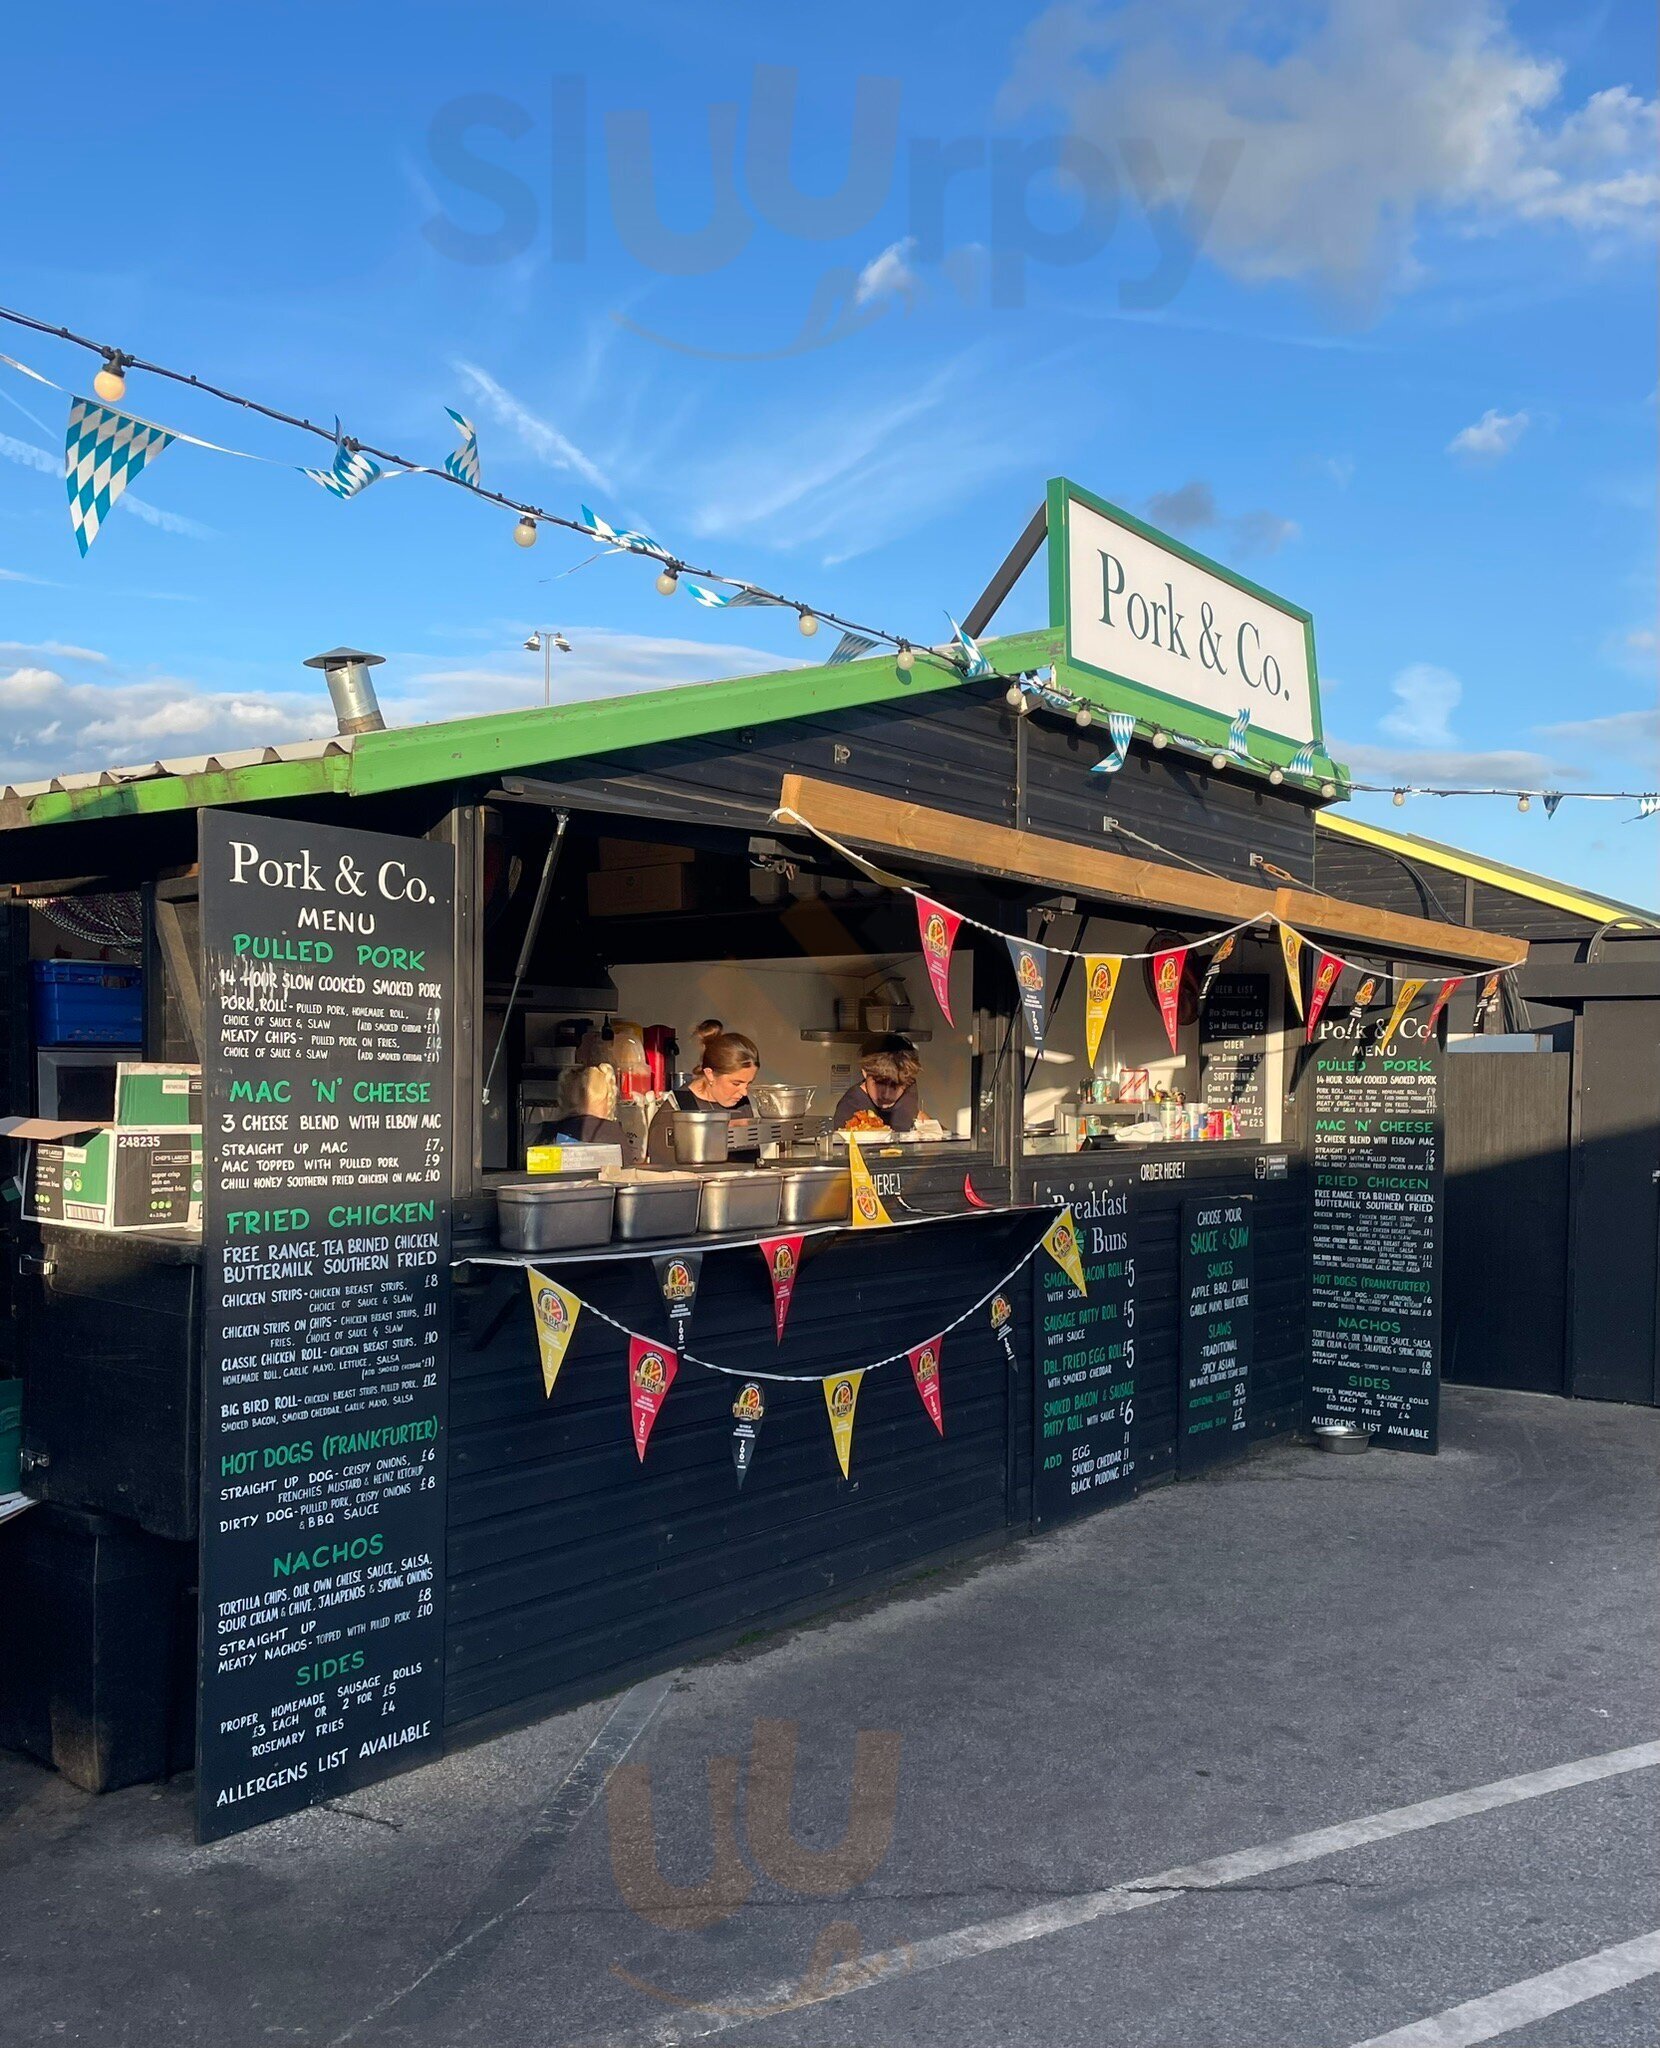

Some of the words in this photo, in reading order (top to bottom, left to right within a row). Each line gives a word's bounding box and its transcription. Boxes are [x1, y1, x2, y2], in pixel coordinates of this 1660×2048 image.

[1097, 549, 1190, 660] Pork
[1200, 601, 1227, 675] &
[1237, 622, 1289, 702] Co.
[229, 842, 326, 891] Pork
[335, 855, 367, 896] &
[378, 861, 435, 904] Co.
[298, 907, 376, 934] MENU
[232, 934, 334, 964] PULLED
[357, 945, 426, 971] PORK
[219, 968, 236, 986] 14
[240, 970, 278, 989] HOUR
[282, 972, 314, 991] SLOW
[318, 975, 365, 994] COOKED
[372, 979, 414, 996] SMOKED
[418, 983, 442, 999] PORK
[1318, 1020, 1368, 1040] Pok
[1352, 1045, 1397, 1056] MENU
[1317, 1060, 1366, 1072] PULLED
[1383, 1060, 1432, 1072] PORK
[1345, 1076, 1363, 1084] SLOW
[1364, 1076, 1387, 1084] COOKED
[1418, 1076, 1437, 1085] PORK
[230, 1080, 292, 1104] MAC
[353, 1082, 431, 1104] CHEESE
[221, 1114, 236, 1132] 3
[242, 1115, 289, 1132] CHEESE
[300, 1115, 339, 1130] BLEND
[349, 1115, 380, 1130] WITH
[386, 1114, 417, 1130] ELBOW
[421, 1114, 442, 1128] MAC
[1315, 1120, 1345, 1131] MAC
[1380, 1121, 1434, 1133] CHEESE
[119, 1136, 161, 1148] 248235
[222, 1143, 284, 1156] STRAIGHT
[293, 1143, 309, 1154] UP
[320, 1142, 348, 1154] MAC
[222, 1161, 249, 1173] MAC
[256, 1160, 295, 1171] TOPPED
[304, 1159, 331, 1170] WITH
[339, 1158, 372, 1168] PULLED
[378, 1157, 399, 1168] PORK
[425, 1154, 440, 1166] £9
[1141, 1163, 1164, 1181] ORDER
[1164, 1162, 1186, 1180] HERE!
[221, 1178, 250, 1189] CHILLI
[254, 1177, 282, 1189] HONEY
[287, 1176, 328, 1187] SOUTHERN
[332, 1176, 354, 1186] FRIED
[358, 1174, 388, 1184] CHICKEN
[393, 1173, 402, 1183] ON
[406, 1173, 422, 1182] MAC
[425, 1170, 441, 1182] £10
[1318, 1175, 1358, 1187] FRIED
[1367, 1177, 1429, 1190] CHICKEN
[227, 1208, 310, 1235] FRIED
[328, 1200, 435, 1228] CHICKEN
[1197, 1209, 1221, 1226] CHOOSE
[1225, 1207, 1242, 1222] YOUR
[223, 1245, 260, 1263] FREE
[322, 1240, 343, 1256] TEA
[347, 1236, 389, 1254] BRINED
[1092, 1226, 1128, 1254] Buns
[1190, 1230, 1218, 1255] SAUCE
[1229, 1226, 1249, 1250] SLAW
[223, 1261, 313, 1284] BUTTERMILK
[324, 1254, 389, 1275] SOUTHERN
[398, 1251, 437, 1268] FRIED
[1108, 1262, 1122, 1278] ROLL
[1124, 1258, 1135, 1288] £5
[1207, 1261, 1233, 1279] SAUCES
[670, 1286, 687, 1296] ABK
[1313, 1274, 1332, 1284] HOT
[1334, 1276, 1357, 1287] DOGS
[1044, 1311, 1076, 1332] SAUSAGE
[1080, 1307, 1100, 1324] PATTY
[1102, 1304, 1117, 1320] ROLL
[1124, 1299, 1134, 1328] £5
[1338, 1317, 1401, 1333] NACHOS
[1048, 1332, 1064, 1346] WITH
[1067, 1329, 1085, 1342] SAUCE
[1208, 1321, 1232, 1339] SLAWS
[1062, 1351, 1087, 1371] FRIED
[1088, 1347, 1105, 1365] EGG
[1109, 1344, 1123, 1360] ROLL
[1122, 1339, 1135, 1369] £5
[640, 1378, 658, 1390] ABK
[1063, 1370, 1087, 1384] SMOKED
[1348, 1375, 1390, 1390] SIDES
[1074, 1390, 1099, 1410] BACON
[739, 1407, 756, 1416] ABK
[1044, 1419, 1064, 1438] PATTY
[1067, 1414, 1083, 1431] ROLL
[1120, 1399, 1134, 1425] £6
[1388, 1426, 1429, 1439] AVAILABLE
[222, 1451, 258, 1476] HOT
[263, 1441, 313, 1467] DOGS
[323, 1415, 438, 1461] (FRANKFURTER)
[1044, 1453, 1062, 1470] ADD
[1072, 1444, 1091, 1461] EGG
[1071, 1477, 1091, 1495] BLACK
[1095, 1466, 1119, 1486] PUDDING
[308, 1513, 334, 1528] BBQ
[344, 1502, 380, 1519] SAUCE
[273, 1534, 384, 1578] NACHOS
[296, 1650, 365, 1686] SIDES
[220, 1713, 259, 1734] PROPER
[272, 1693, 325, 1717] HOMEMADE
[337, 1675, 381, 1697] SAUSAGE
[393, 1663, 423, 1680] ROLLS
[252, 1724, 266, 1739] £3
[272, 1714, 299, 1732] EACH
[315, 1706, 327, 1718] OR
[342, 1699, 350, 1710] 2
[357, 1691, 372, 1704] FOR
[382, 1682, 397, 1697] £5
[252, 1730, 306, 1757] ROSEMARY
[316, 1719, 345, 1737] FRIES
[381, 1701, 395, 1715] £4
[217, 1762, 308, 1807] ALLERGENS
[318, 1748, 349, 1772] LIST
[359, 1720, 431, 1758] AVAILABLE
